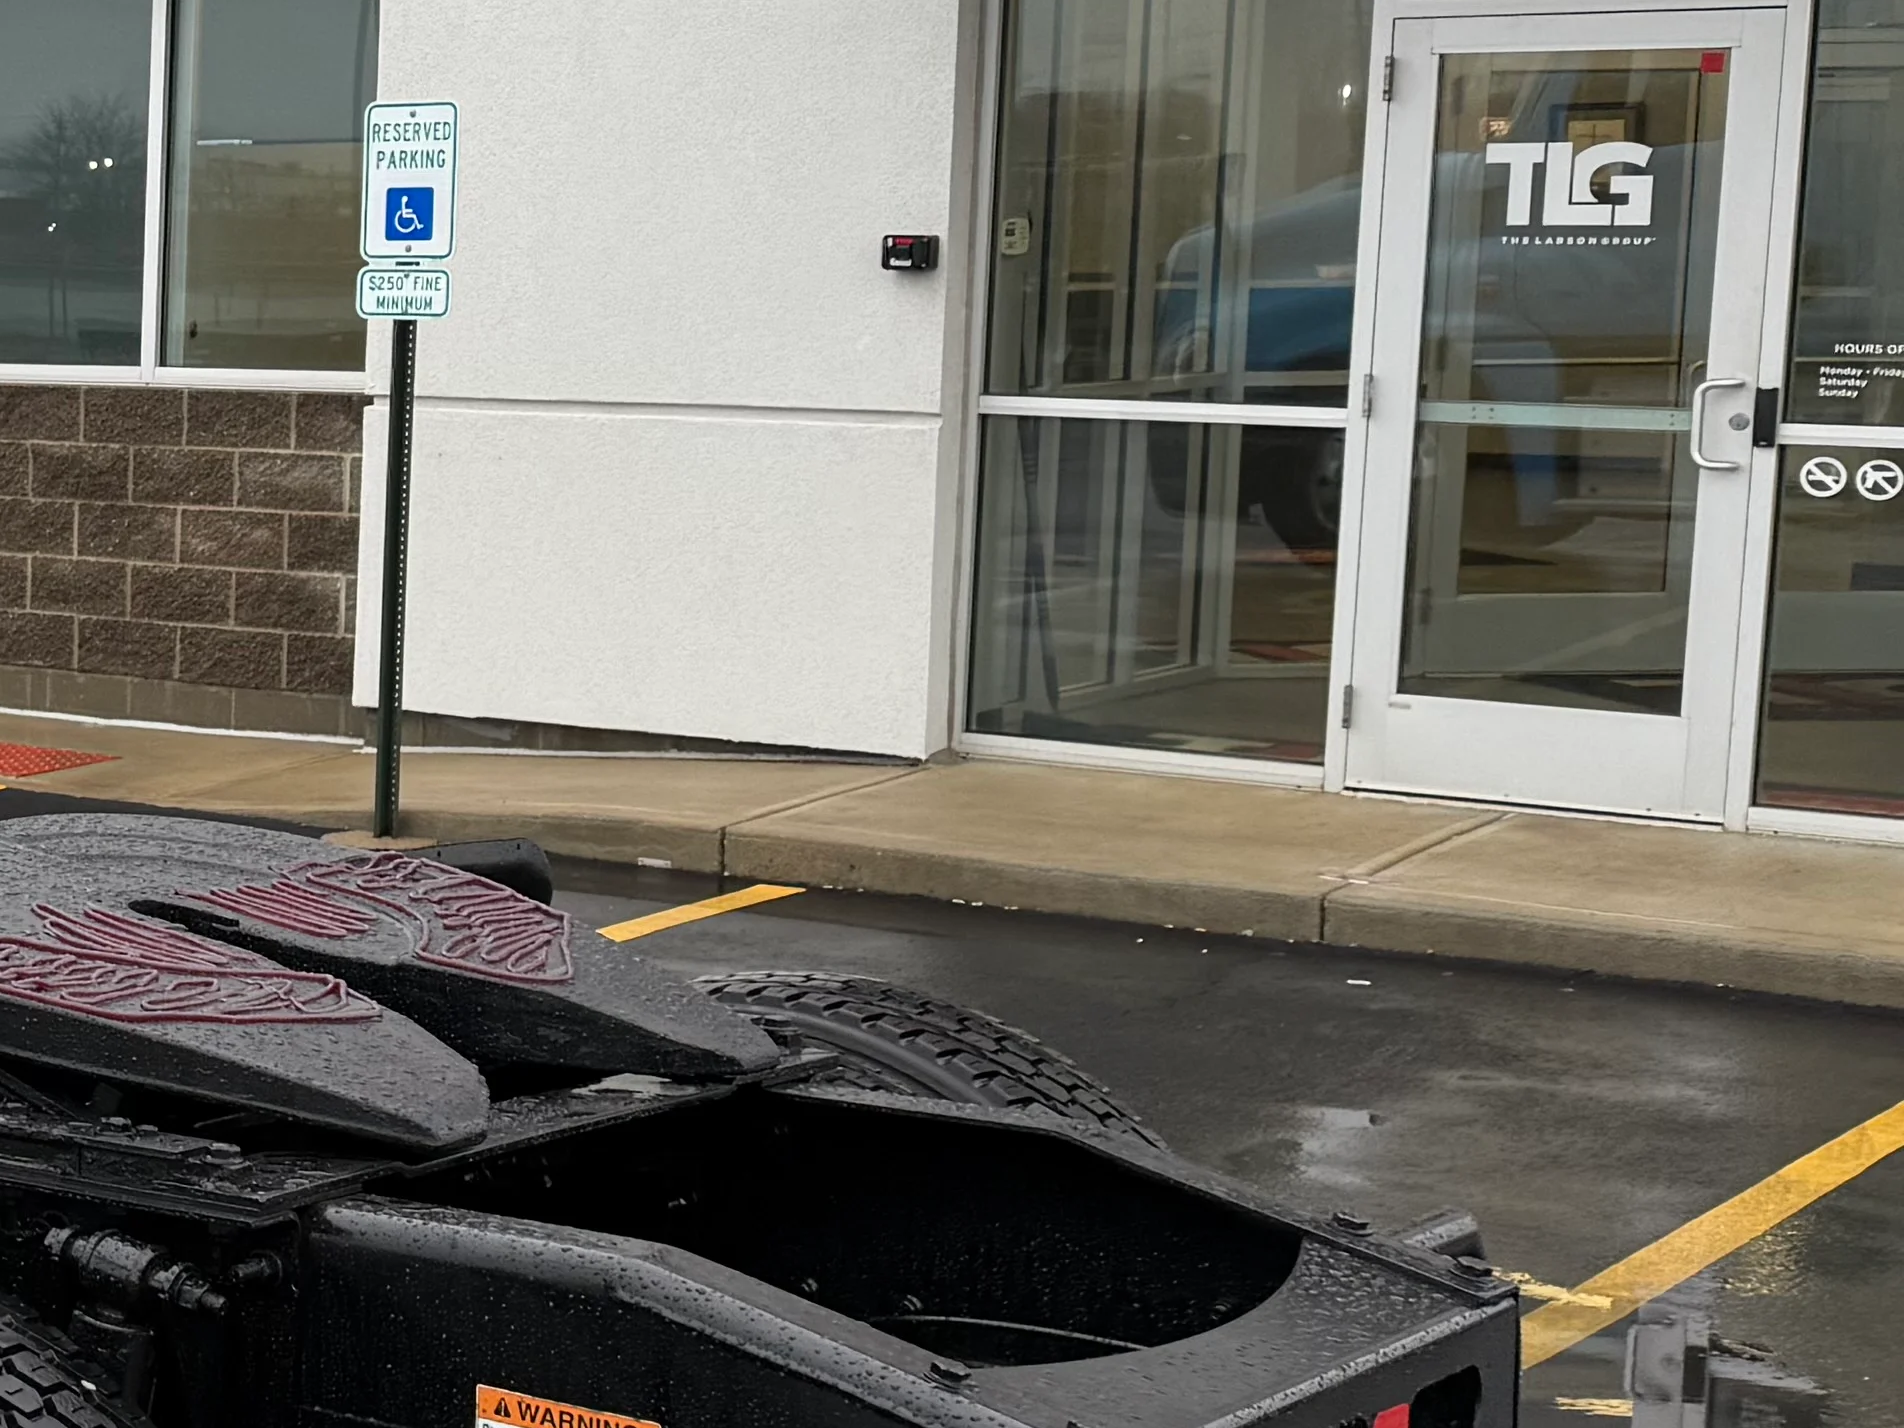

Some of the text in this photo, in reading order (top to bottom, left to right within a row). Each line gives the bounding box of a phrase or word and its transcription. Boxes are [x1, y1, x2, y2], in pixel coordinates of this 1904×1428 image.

[372, 121, 452, 143] RESERVED
[376, 148, 446, 171] PARKING
[1485, 141, 1654, 227] TLG
[368, 275, 443, 292] $250 FINE
[376, 295, 433, 312] MINIMUM
[1834, 343, 1883, 355] HOURS
[1819, 366, 1863, 377] Monday
[1819, 376, 1868, 388] Saturday
[1818, 387, 1859, 398] Sunday
